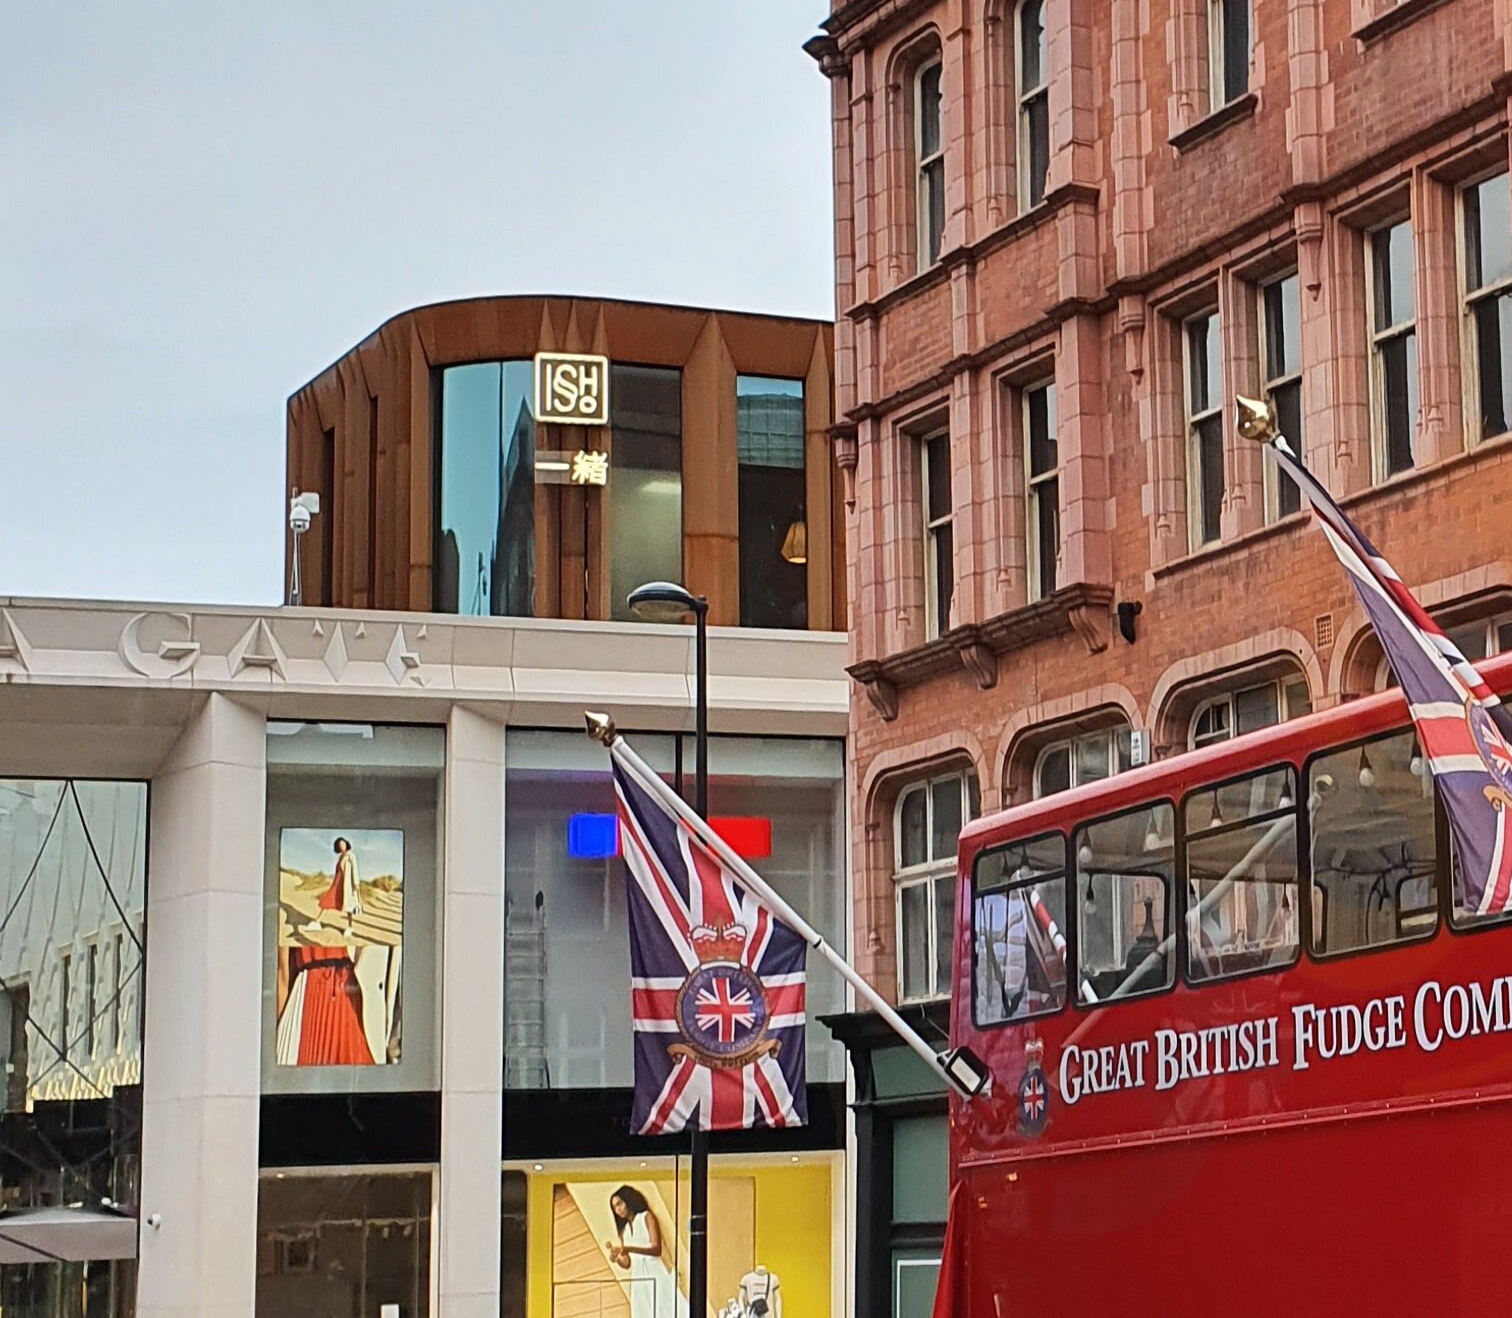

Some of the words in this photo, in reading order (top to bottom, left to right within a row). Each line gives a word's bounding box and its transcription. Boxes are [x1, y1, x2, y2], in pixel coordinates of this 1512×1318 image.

[118, 612, 428, 687] GATE
[1059, 1039, 1150, 1105] GREAT
[1154, 1016, 1280, 1091] BRITISH
[1291, 995, 1407, 1071] FUDGE
